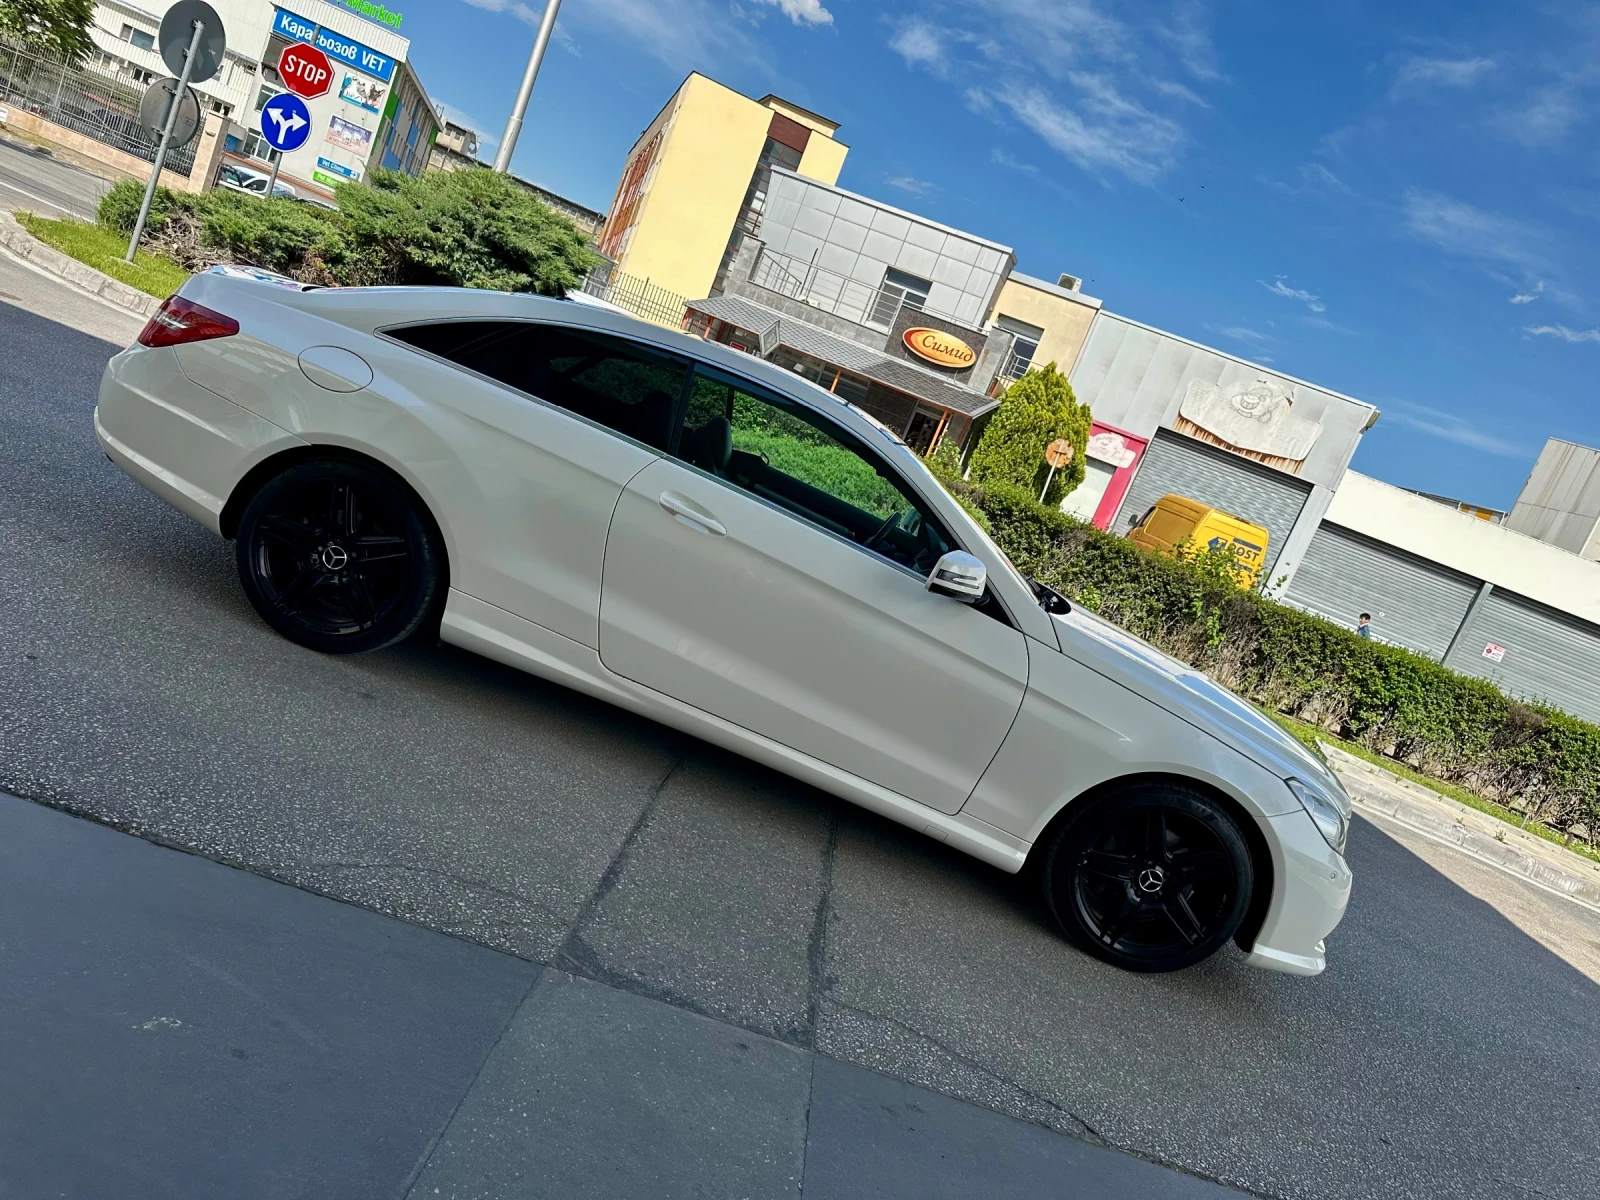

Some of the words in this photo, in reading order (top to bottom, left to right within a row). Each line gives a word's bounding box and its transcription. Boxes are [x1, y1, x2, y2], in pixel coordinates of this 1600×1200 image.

[281, 15, 357, 60] Караьозов
[362, 51, 387, 72] VET
[285, 54, 327, 85] STOP
[922, 335, 973, 362] Симид
